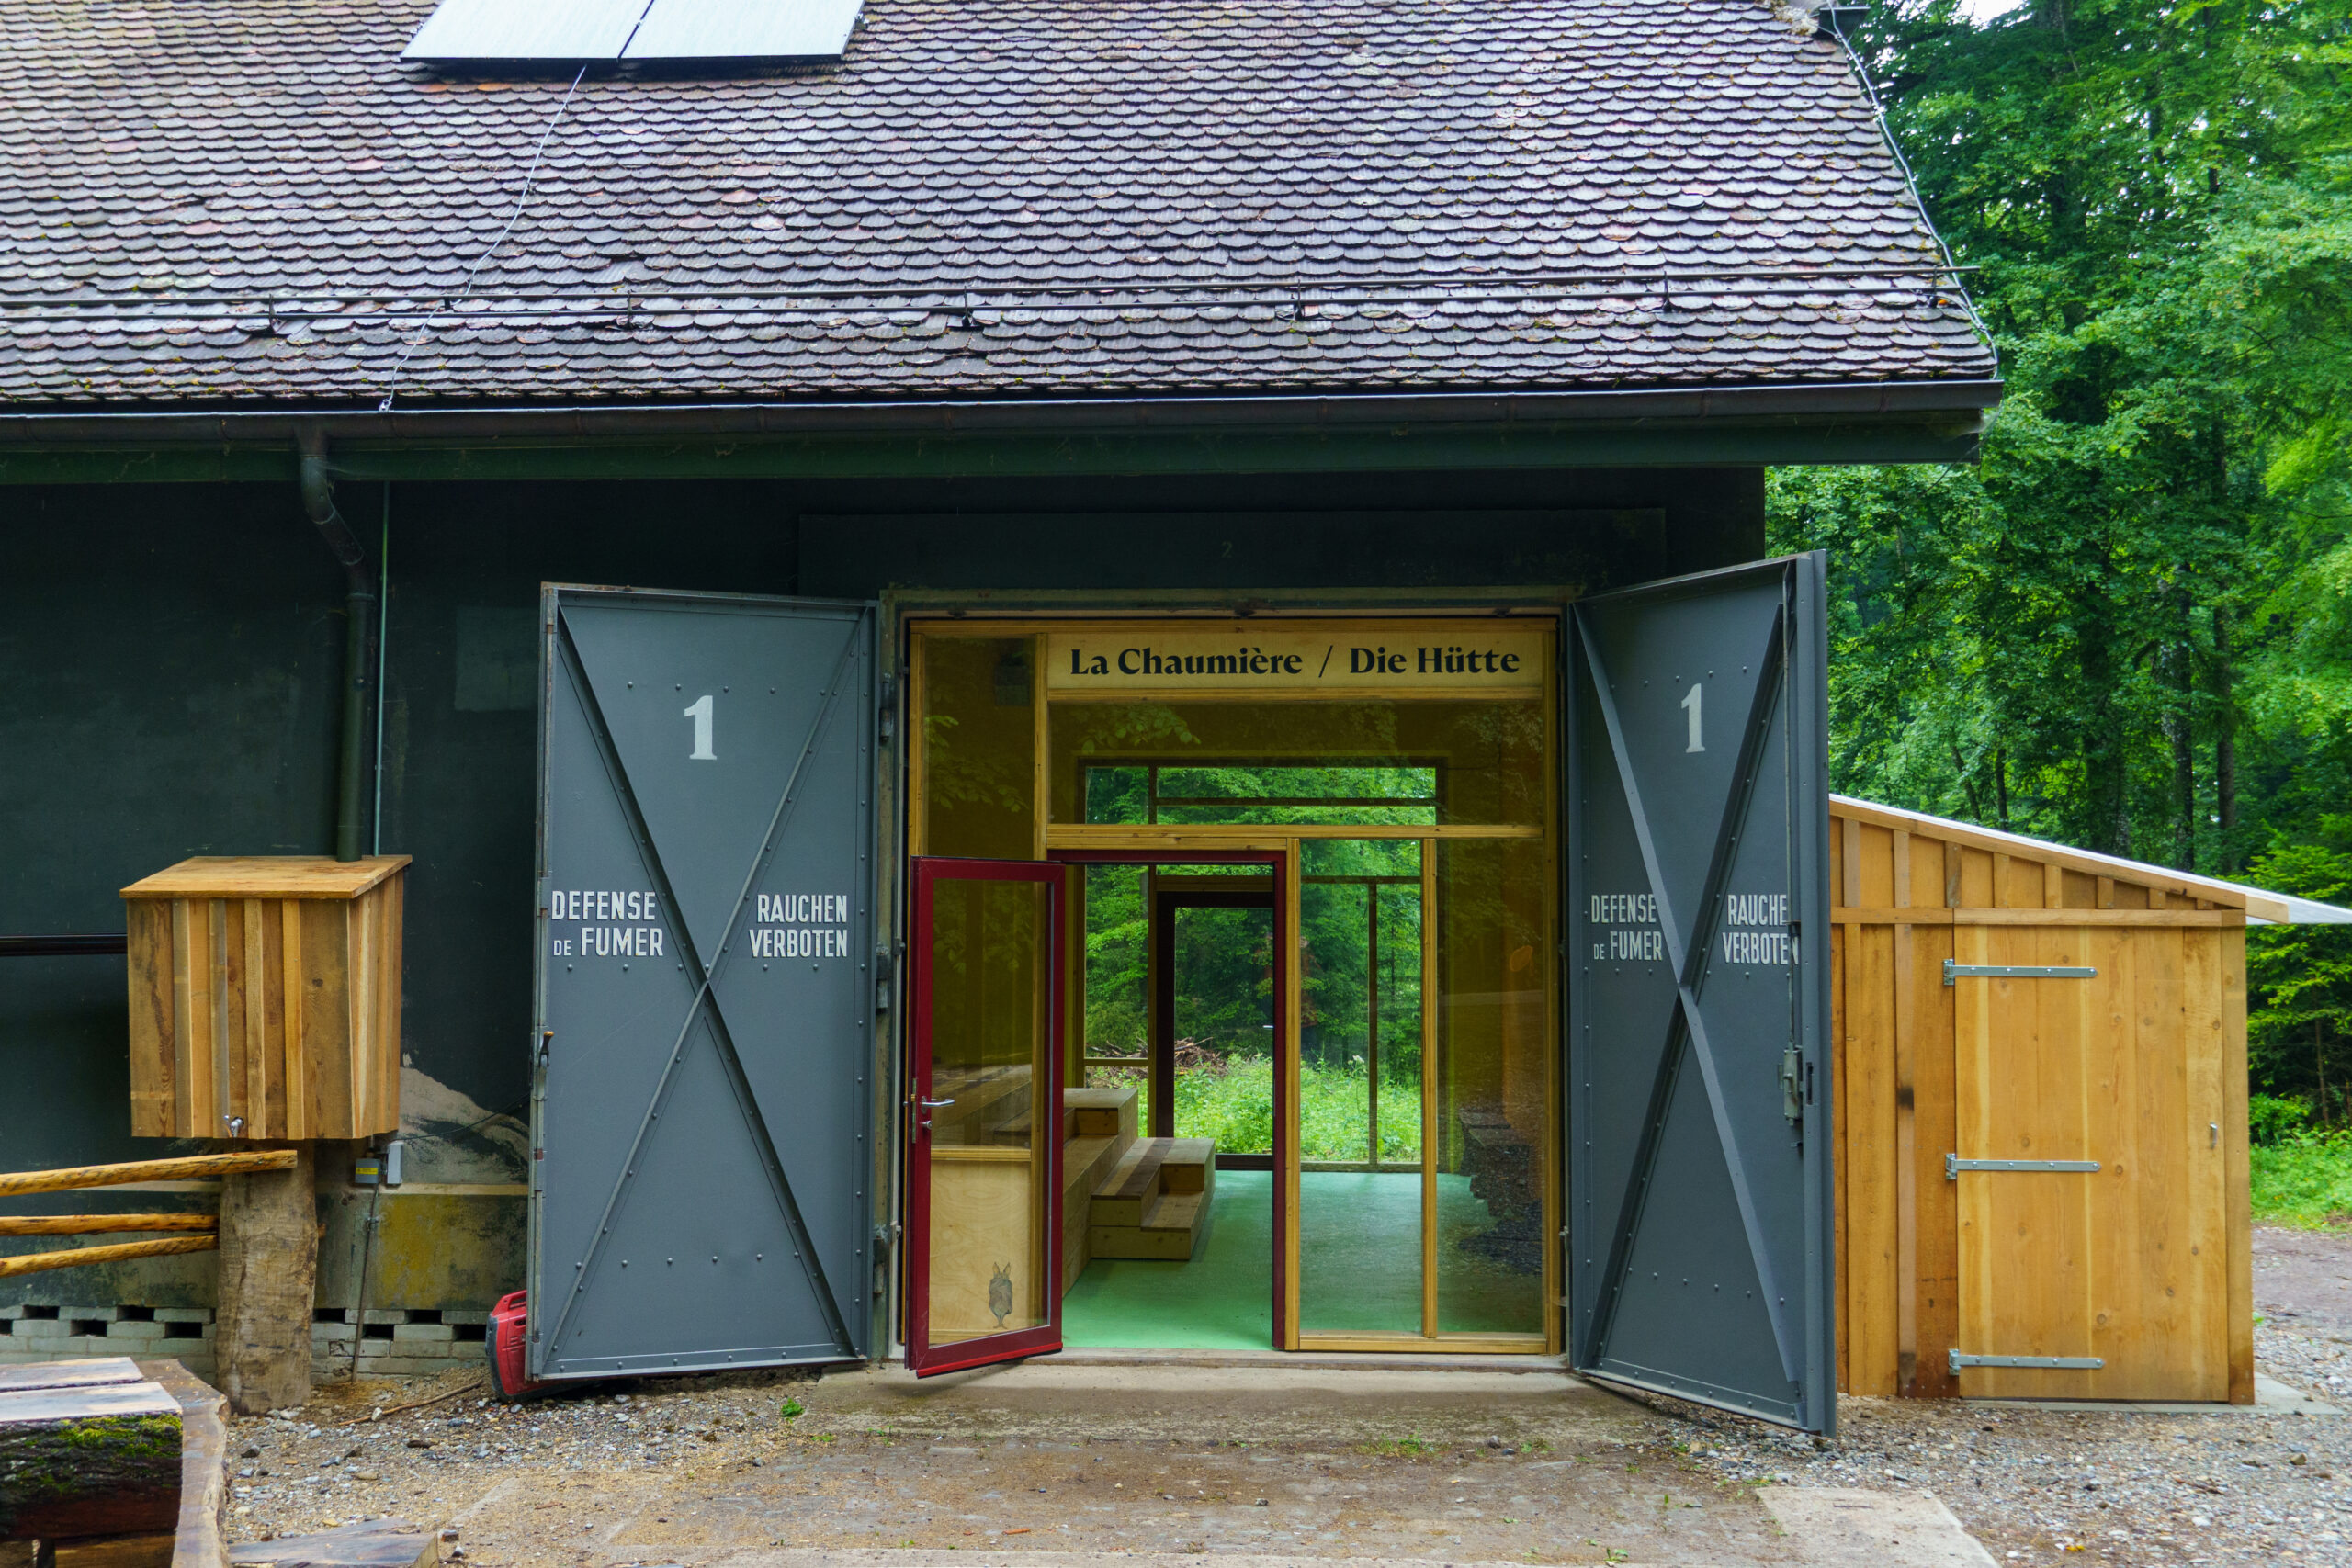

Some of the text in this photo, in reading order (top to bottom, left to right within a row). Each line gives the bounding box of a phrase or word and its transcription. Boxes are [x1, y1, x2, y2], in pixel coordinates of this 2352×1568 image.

[1070, 645, 1520, 678] La Chaumière / Die Hütte
[684, 694, 718, 761] 1
[1680, 682, 1706, 753] 1
[551, 890, 656, 920] DEFENSE
[757, 894, 847, 923] RAUCHEN
[1590, 894, 1657, 923] DEFENSE
[1727, 894, 1788, 926] RAUCHE
[553, 927, 664, 957] DE FUMER
[749, 929, 848, 958] VERBOTEN
[1593, 931, 1663, 961] DE FUMER
